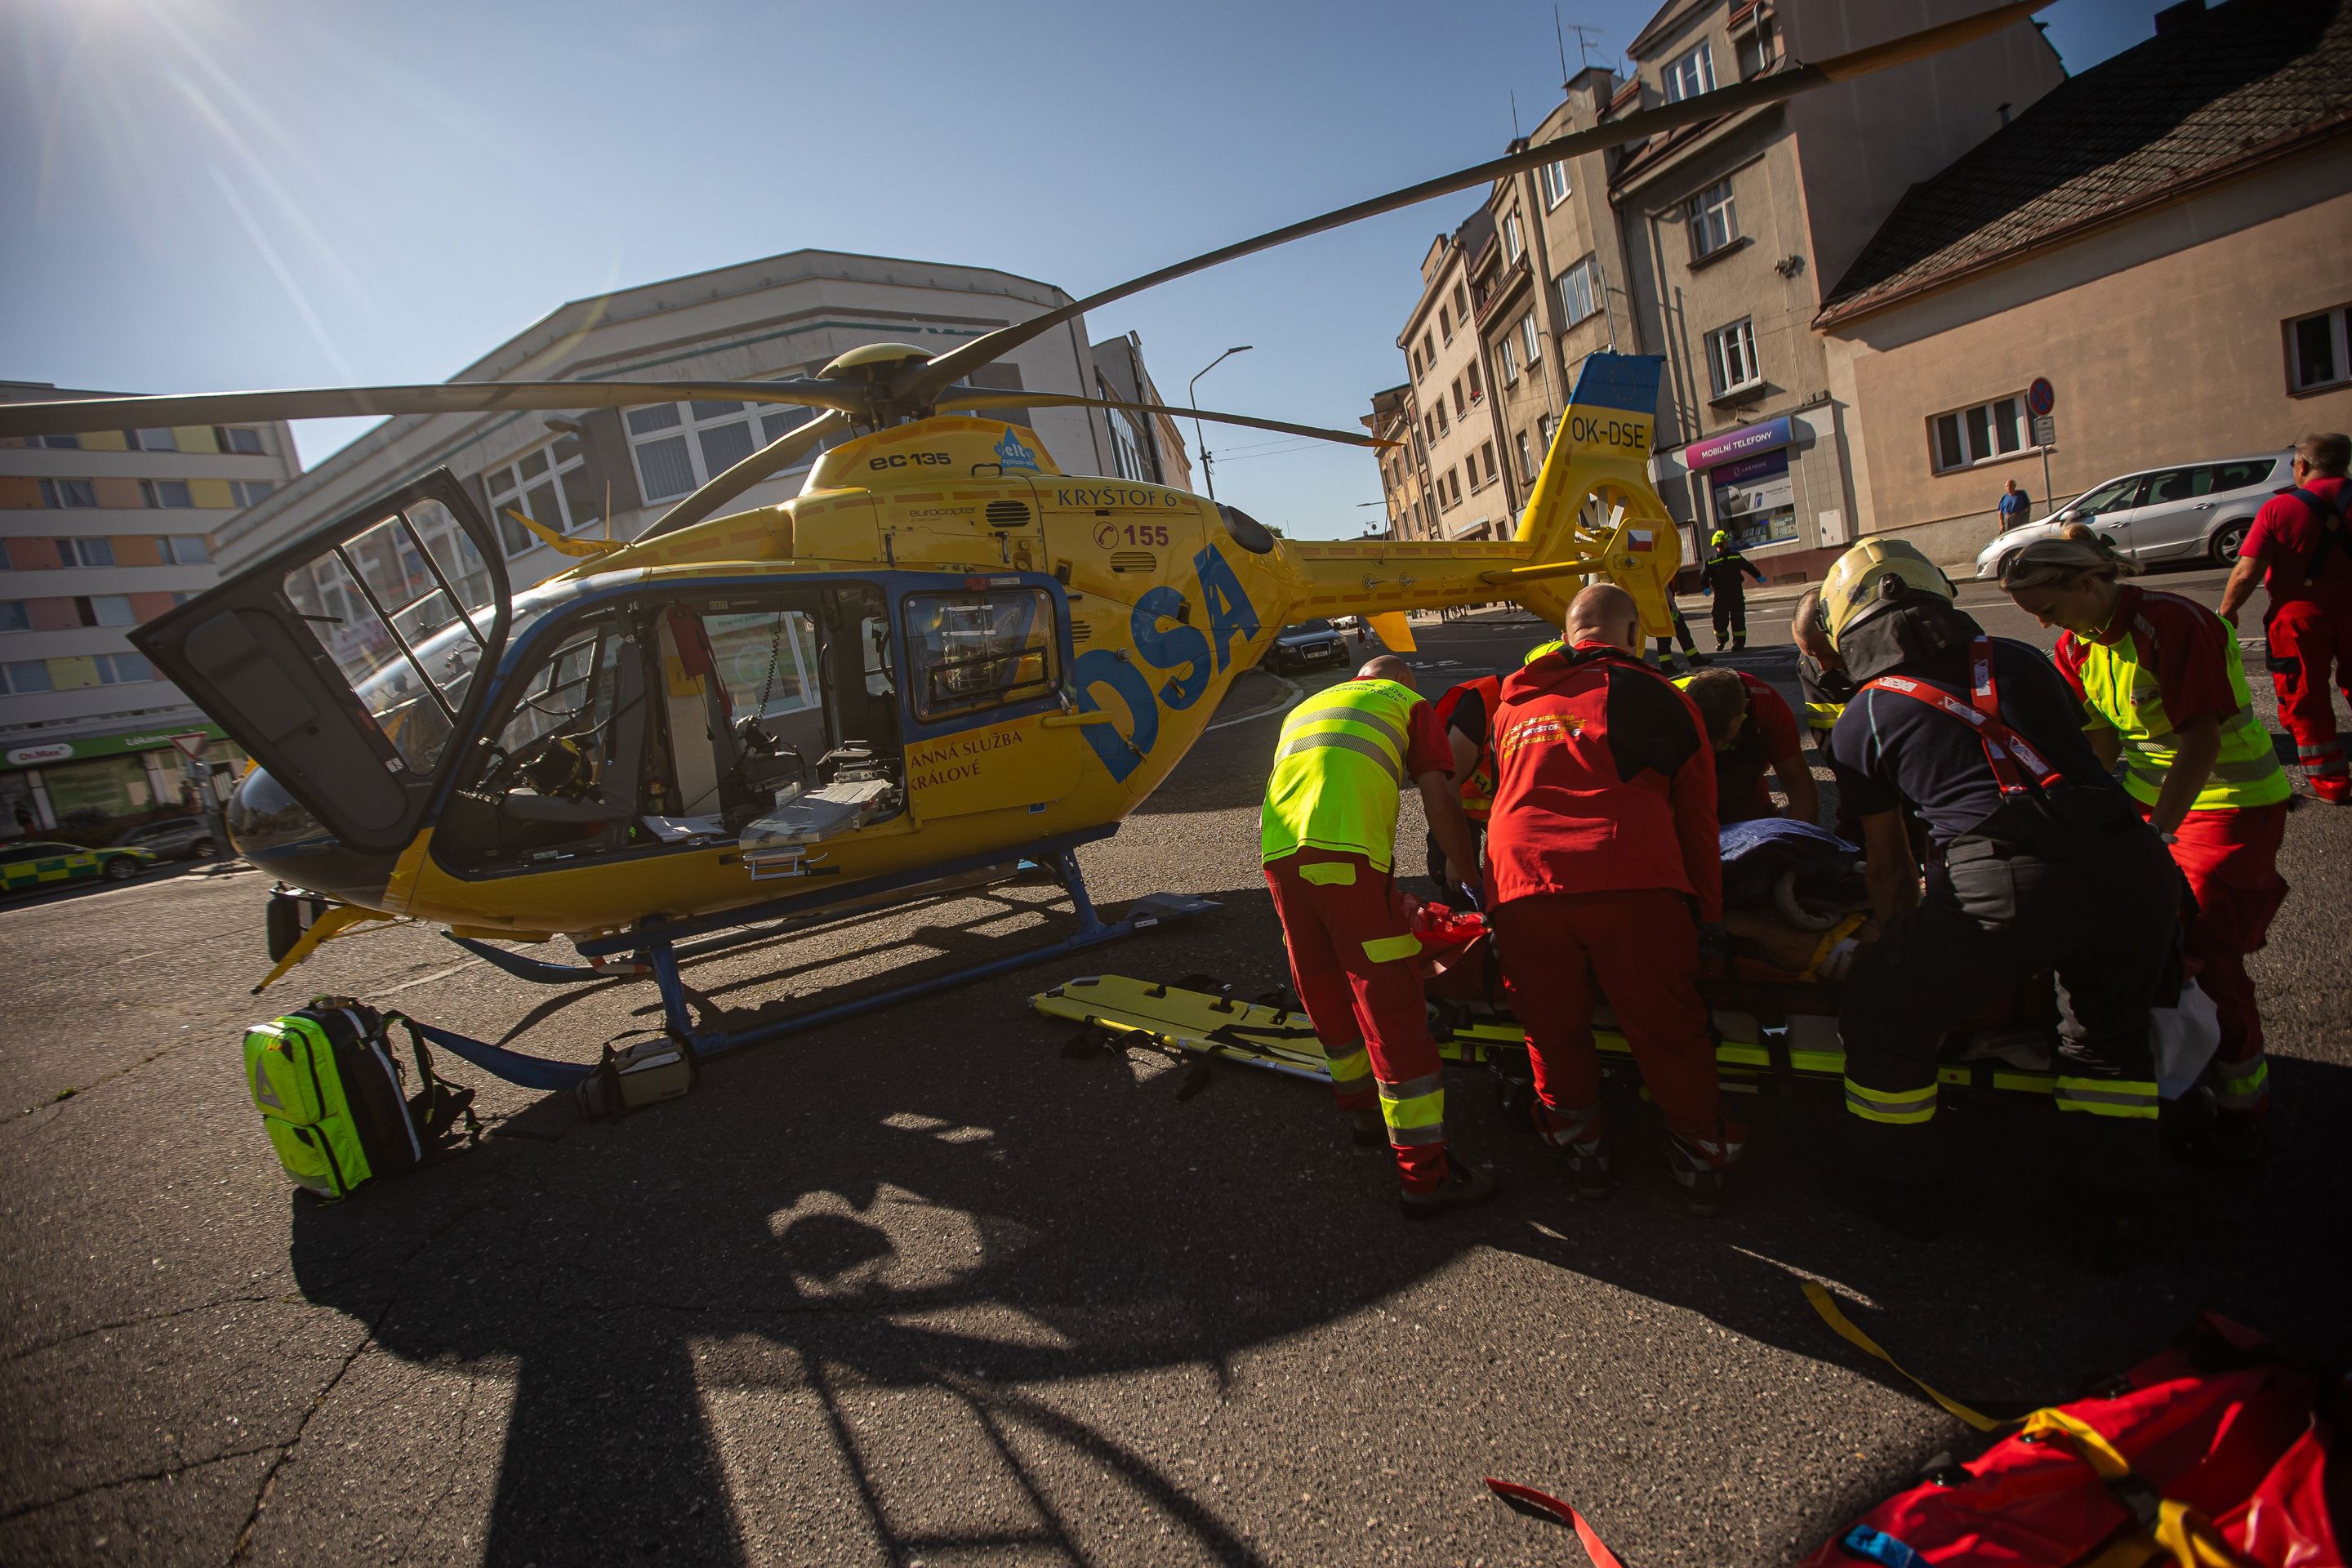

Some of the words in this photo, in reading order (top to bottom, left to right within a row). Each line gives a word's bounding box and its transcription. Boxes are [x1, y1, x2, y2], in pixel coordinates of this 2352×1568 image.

[1572, 416, 1645, 448] OK-DSE
[1701, 442, 1731, 459] MOBILNÍ
[1733, 431, 1772, 449] TELEFONY
[1058, 486, 1156, 506] KRYŠTOF
[1164, 492, 1177, 507] 6
[909, 506, 977, 518] eurocopter
[1124, 524, 1169, 547] 155
[1074, 542, 1262, 785] DSA
[962, 731, 1022, 756] SLUŽBA
